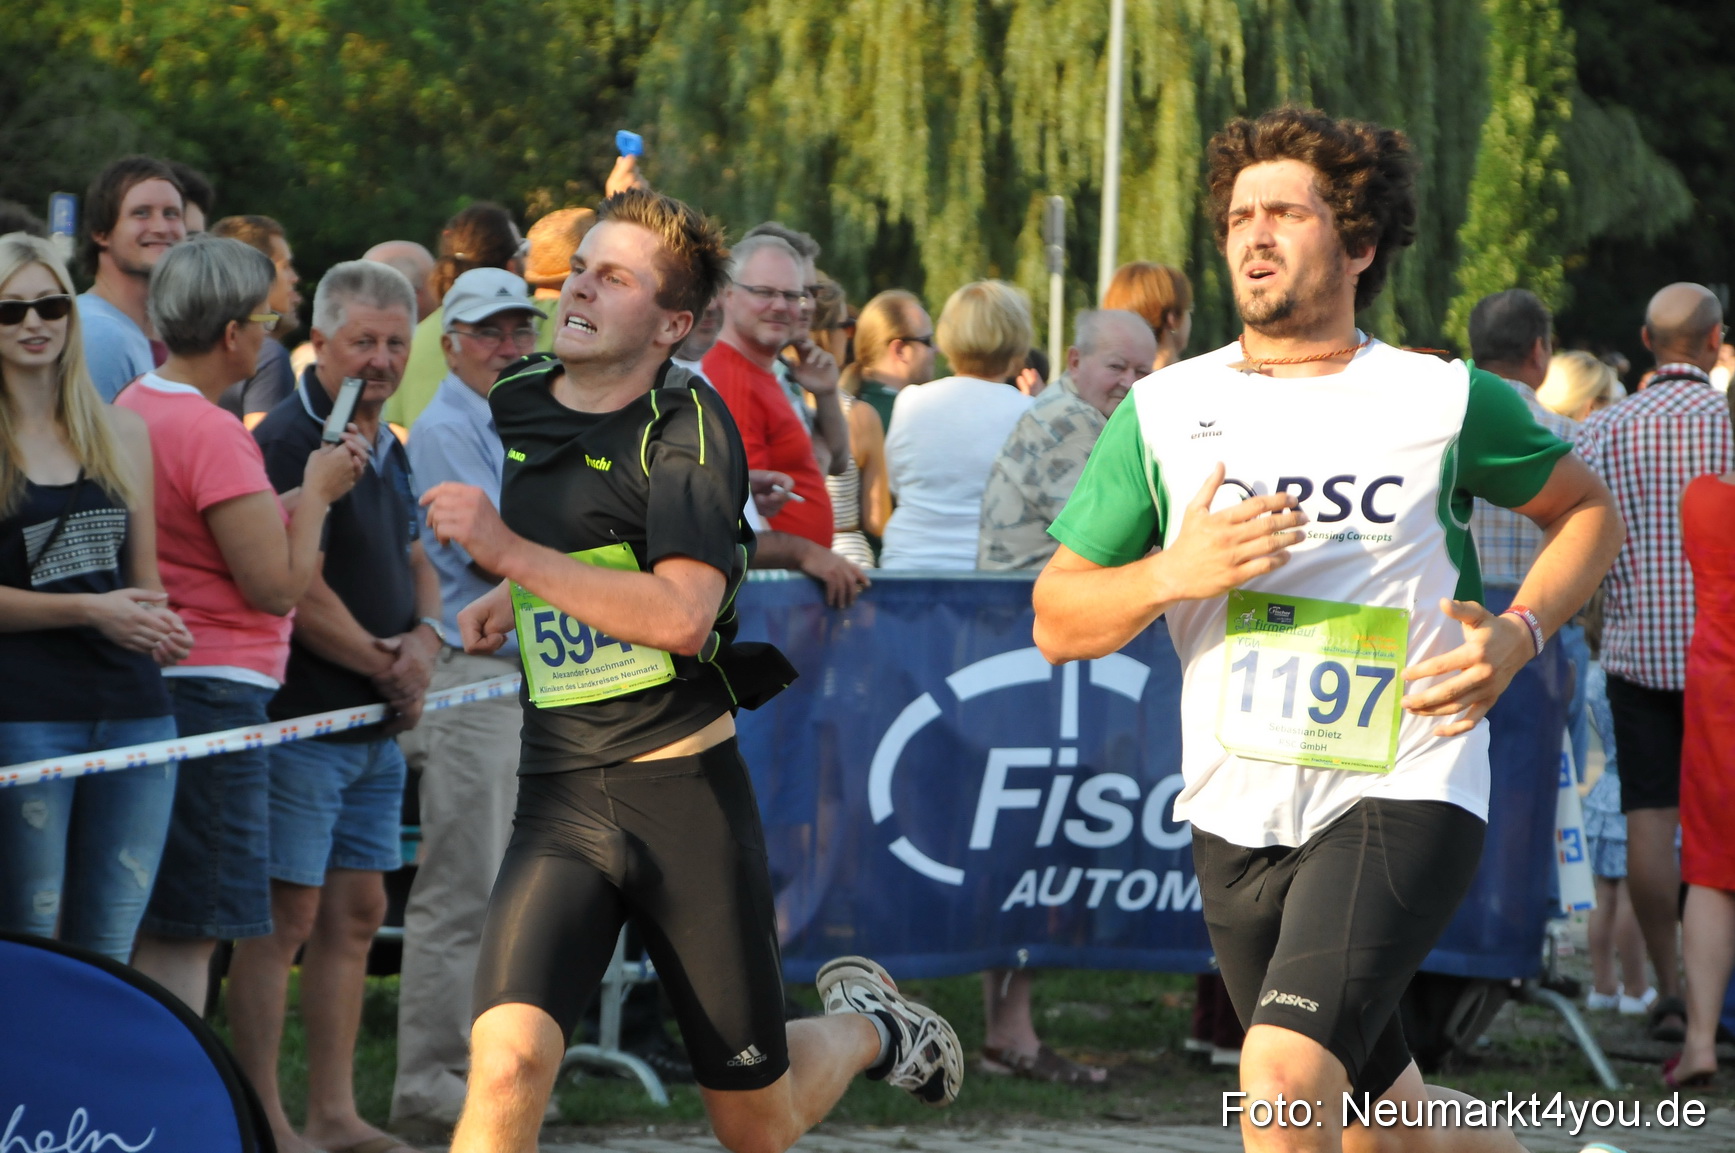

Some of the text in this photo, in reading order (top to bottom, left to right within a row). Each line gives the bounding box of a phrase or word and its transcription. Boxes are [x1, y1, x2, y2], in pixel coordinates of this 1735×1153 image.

[1191, 430, 1223, 440] erima
[1307, 530, 1393, 543] Sensing Concepts
[1255, 618, 1317, 639] firmenlauf
[552, 658, 636, 680] Alexander Puschmann
[539, 685, 565, 694] Kliniken
[565, 683, 577, 691] des
[577, 675, 619, 689] Landkreises
[620, 664, 659, 680] Neumarkt
[1231, 649, 1396, 729] 1197
[1269, 722, 1342, 740] Sebastian Dietz
[1300, 741, 1328, 752] GmbH
[1275, 992, 1320, 1013] asics
[726, 1053, 768, 1067] adidas
